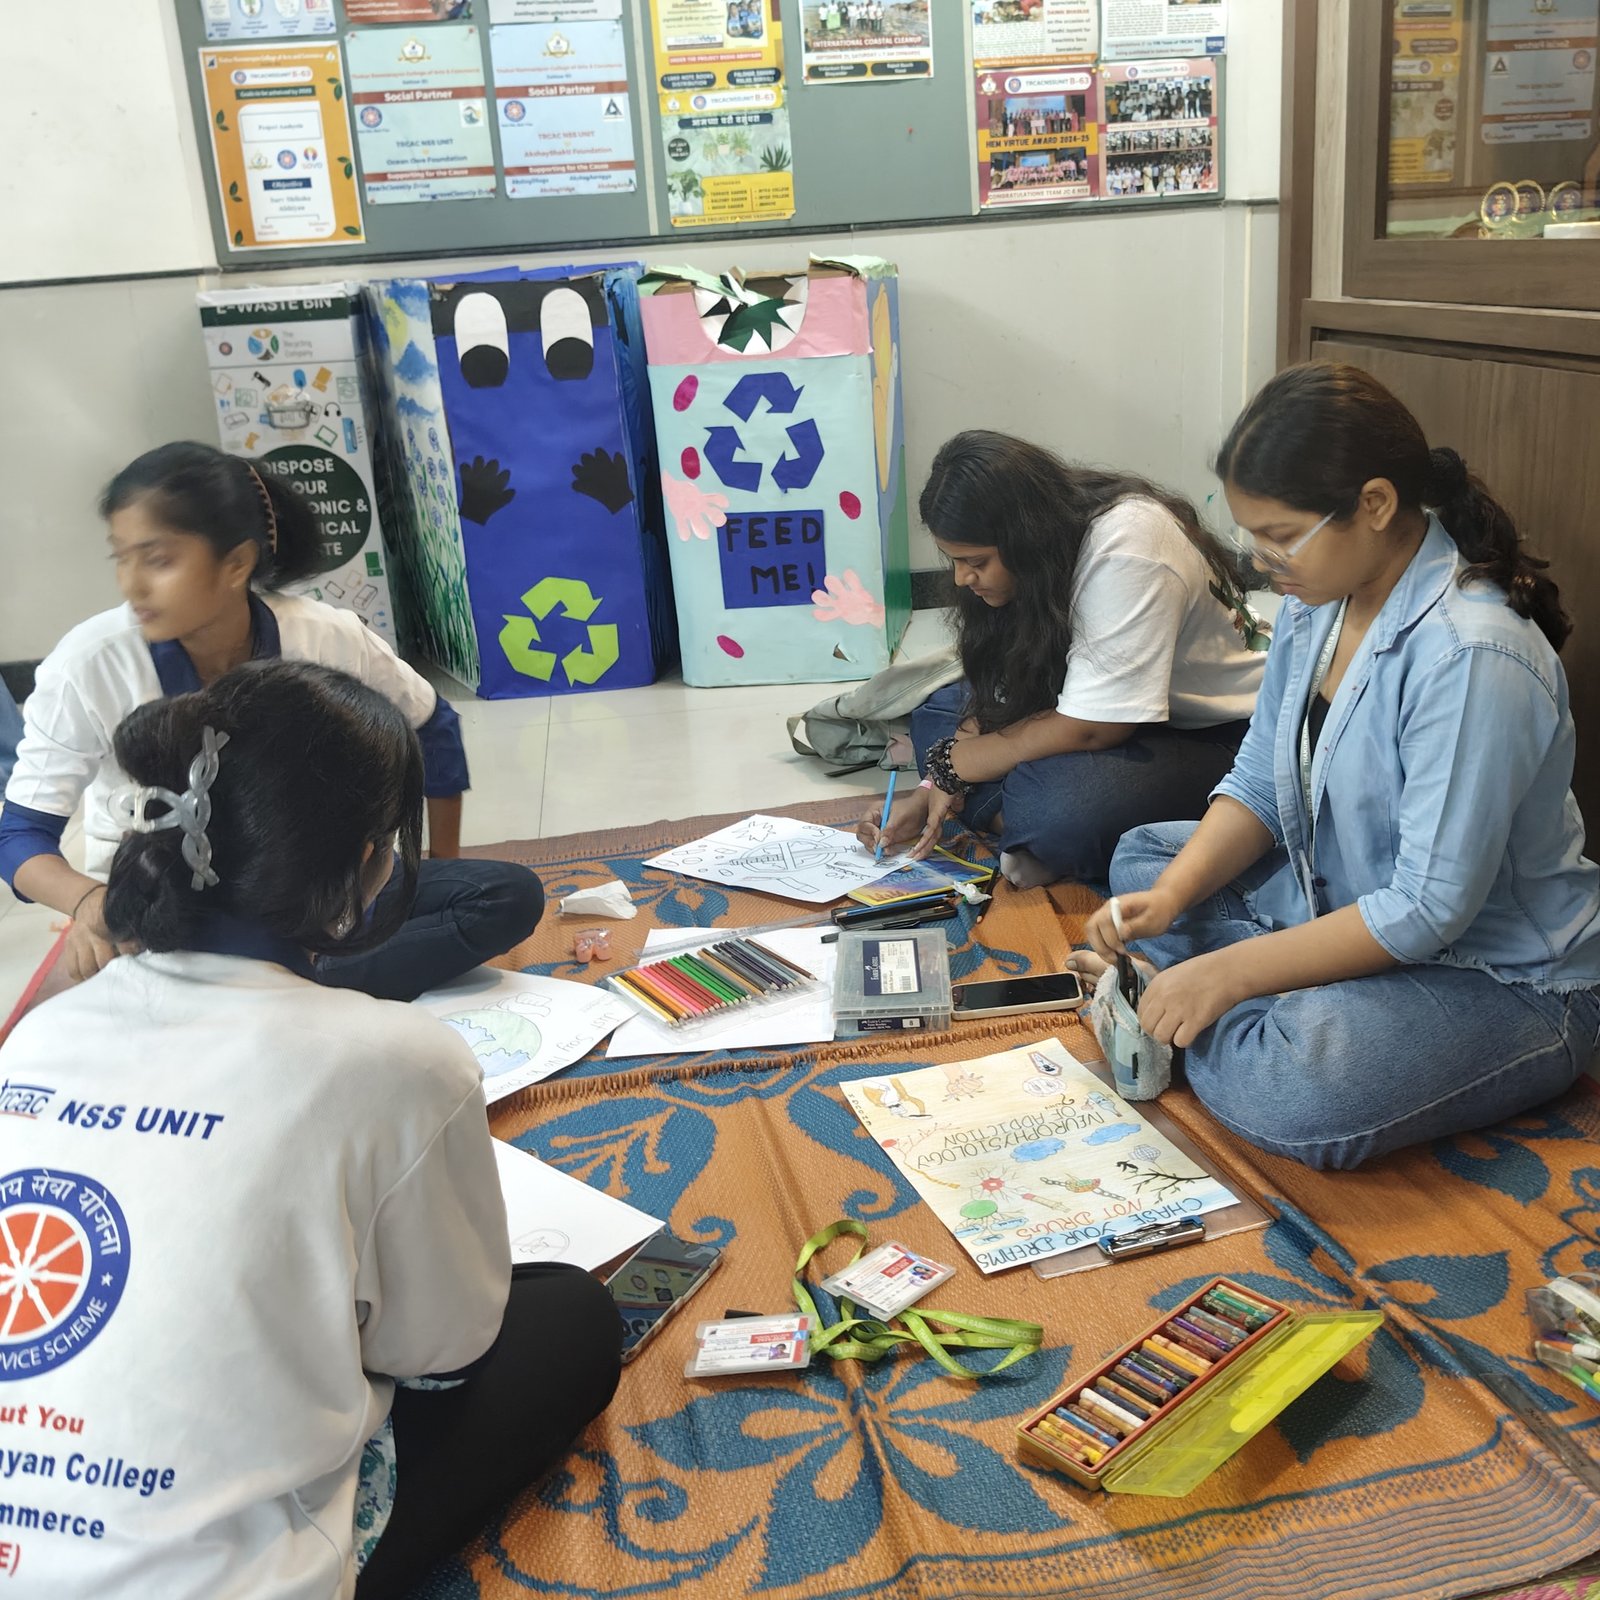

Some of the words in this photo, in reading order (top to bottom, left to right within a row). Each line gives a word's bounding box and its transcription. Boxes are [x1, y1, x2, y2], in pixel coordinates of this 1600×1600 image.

[813, 39, 863, 48] INTERNATIONAL
[864, 37, 893, 46] COASTAL
[894, 35, 922, 44] CLEANUP
[384, 91, 414, 102] Social
[416, 90, 453, 100] Partner
[528, 86, 558, 97] Social
[559, 85, 596, 95] Partner
[1004, 138, 1029, 147] VIRTUE
[1032, 136, 1057, 145] AWARD
[216, 299, 298, 314] E-WASTE
[303, 297, 332, 310] BIN
[292, 480, 328, 494] OUR
[356, 499, 369, 512] &
[726, 516, 821, 552] FEED
[751, 562, 820, 594] ME!
[57, 1100, 128, 1130] NSS
[134, 1104, 224, 1141] UNIT
[943, 1111, 1046, 1149] ADDICTION
[31, 1168, 77, 1203] सेवा
[79, 1185, 122, 1256] योजना
[1127, 1196, 1204, 1226] CHASE
[1063, 1220, 1117, 1246] YOUR
[975, 1234, 1057, 1270] DREAMS
[0, 1347, 42, 1372] VICE
[43, 1296, 109, 1362] SCHEME
[1016, 1329, 1043, 1341] COLLE
[0, 1404, 28, 1426] ut
[38, 1404, 85, 1435] You
[0, 1447, 56, 1479] yan
[66, 1453, 176, 1498] College
[0, 1502, 105, 1540] mmerce
[0, 1541, 21, 1578] E)
